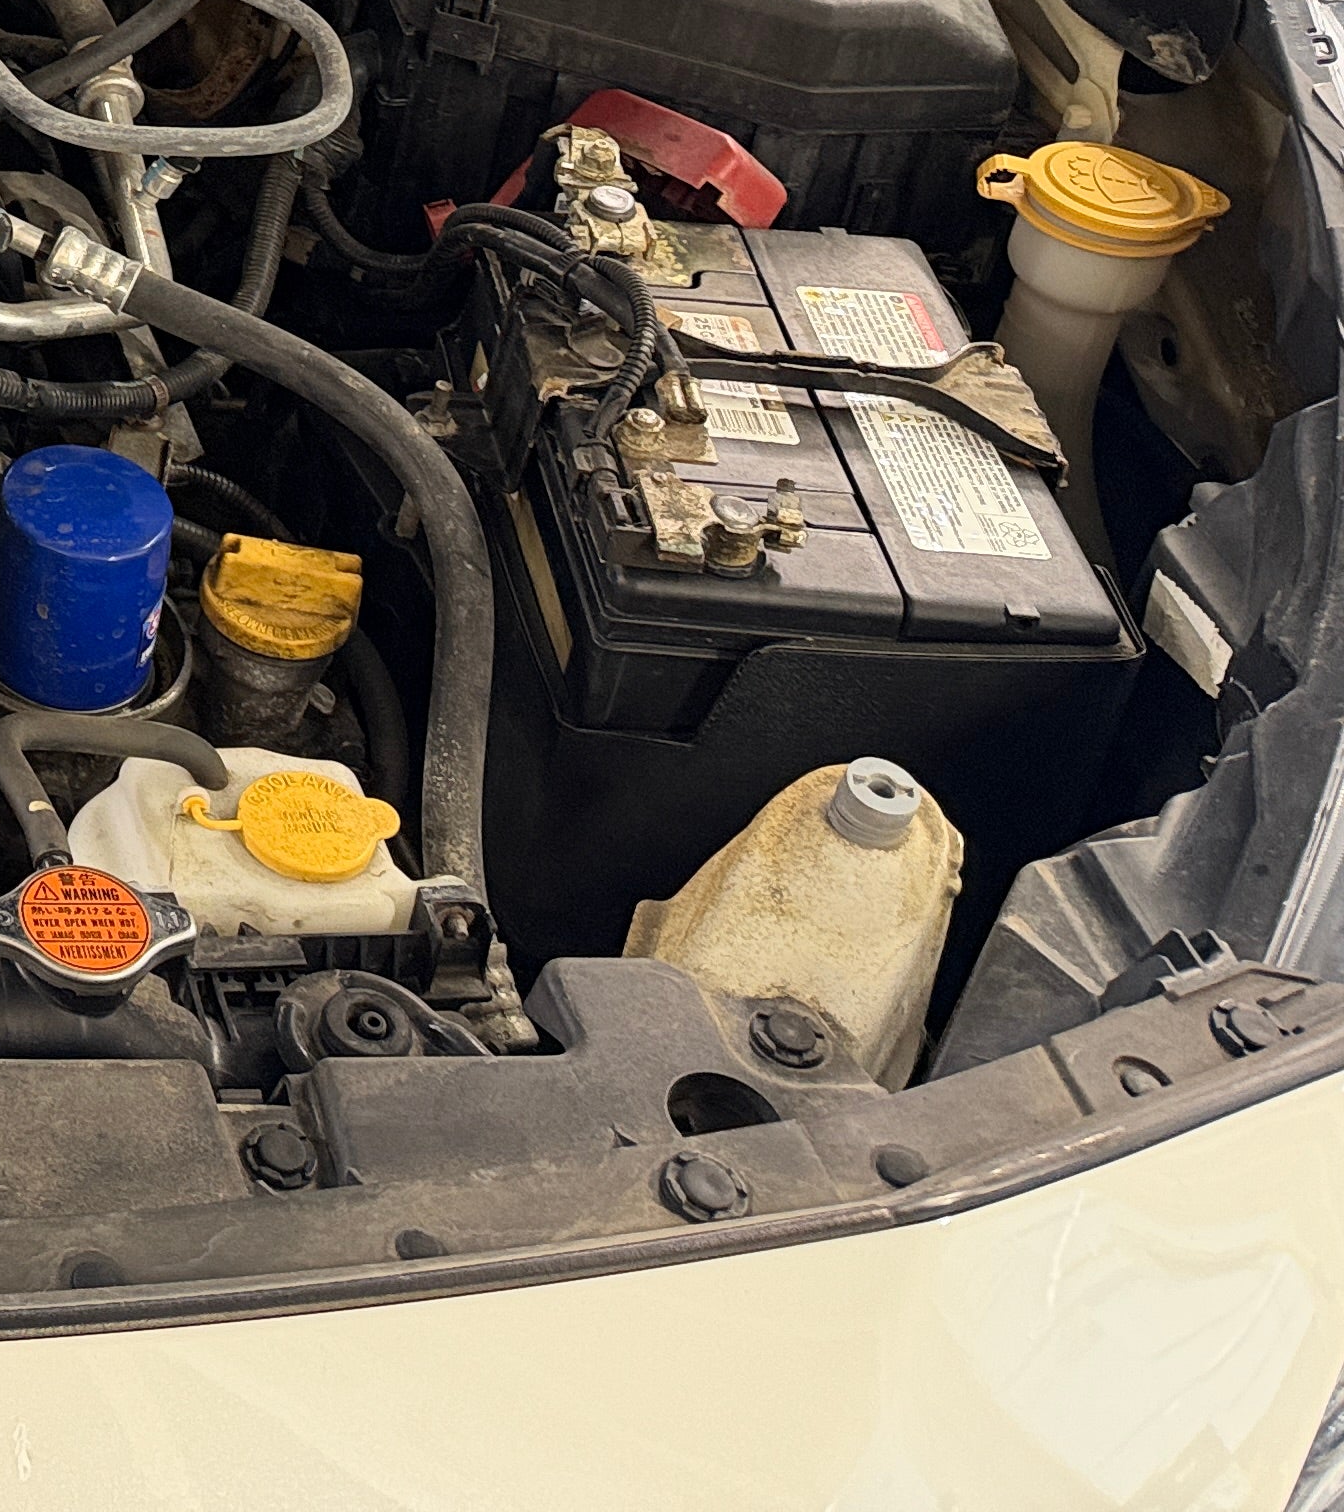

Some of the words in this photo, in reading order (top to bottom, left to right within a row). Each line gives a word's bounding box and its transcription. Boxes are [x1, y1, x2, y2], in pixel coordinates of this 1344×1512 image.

[61, 888, 120, 901] WARNING
[32, 918, 61, 927] NEVER
[64, 918, 87, 927] OPEN
[90, 918, 115, 927] WHEN
